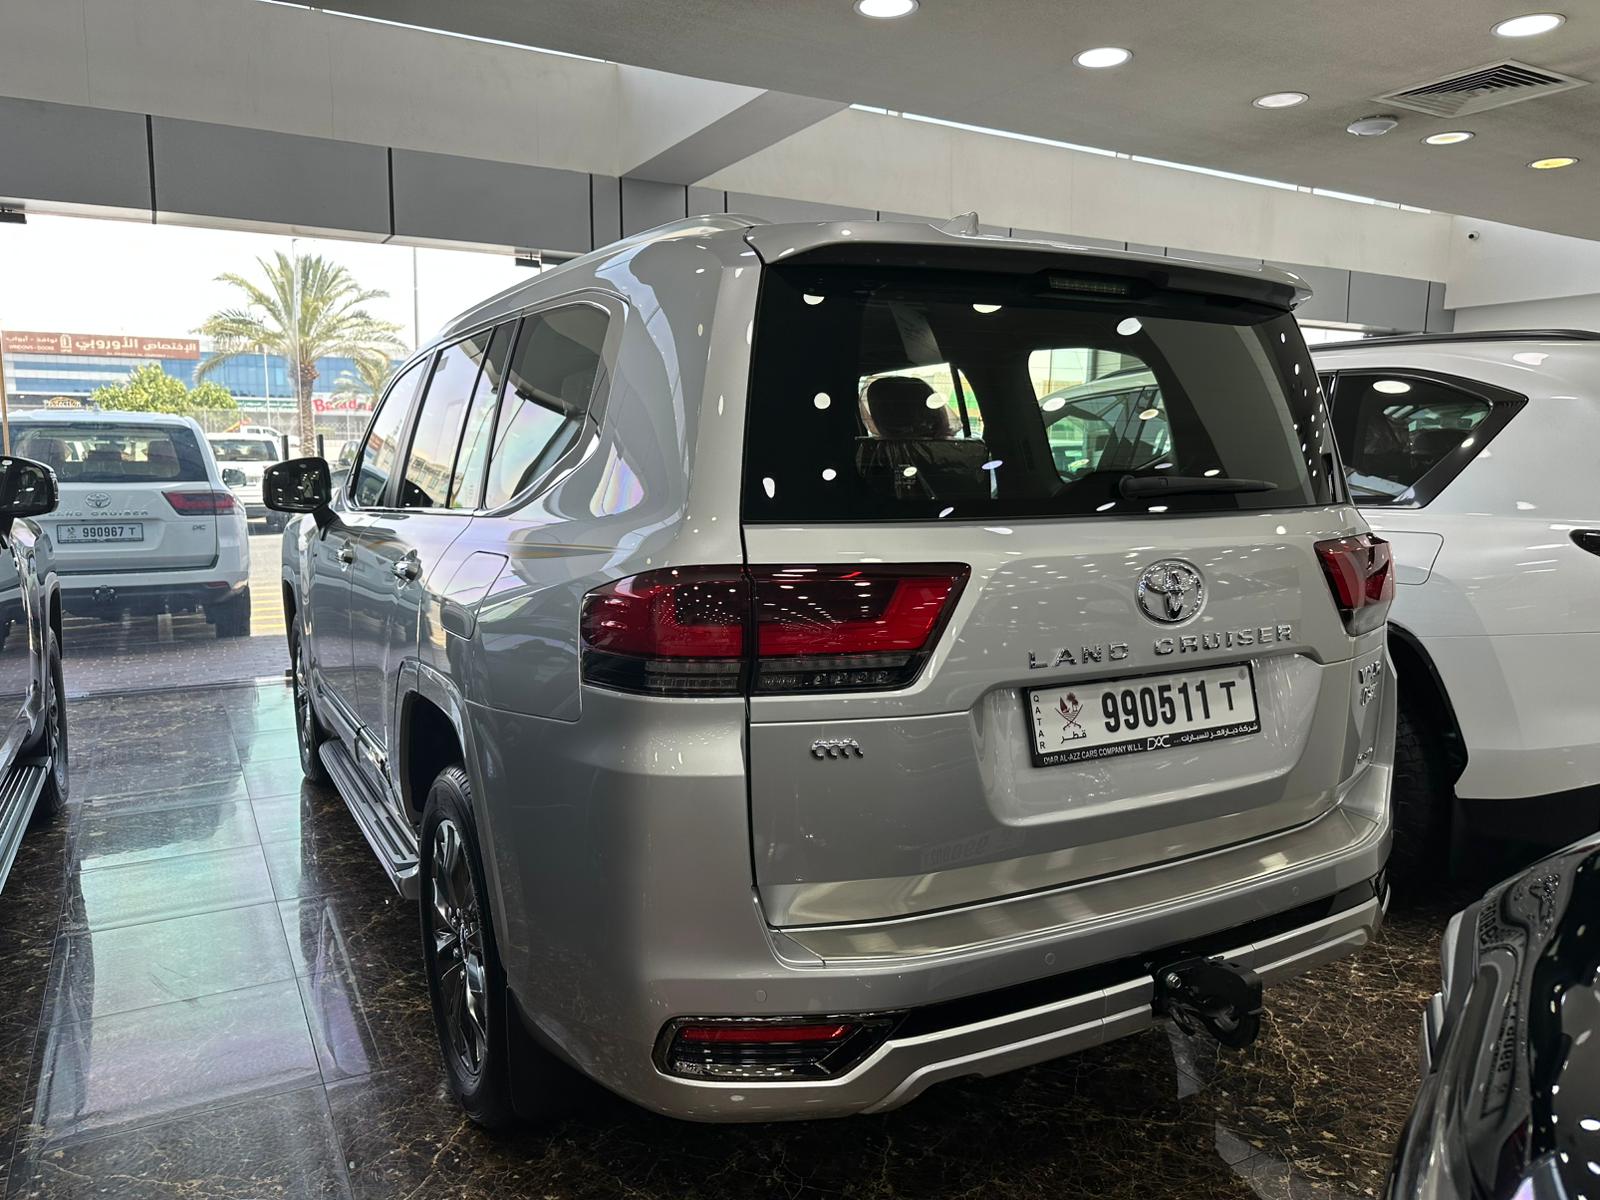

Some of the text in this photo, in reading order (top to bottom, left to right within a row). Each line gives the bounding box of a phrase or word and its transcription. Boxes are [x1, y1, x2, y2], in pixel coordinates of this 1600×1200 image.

[75, 336, 139, 351] الأوروبي
[143, 341, 197, 353] الإختصاص
[82, 526, 136, 538] 990967 T
[1028, 624, 1293, 670] LAND CRUISER
[1101, 680, 1236, 733] 990511 T
[1033, 694, 1046, 750] QATAR
[1060, 729, 1087, 744] قطر
[1081, 749, 1098, 759] CARS
[1099, 745, 1128, 756] COMPANY
